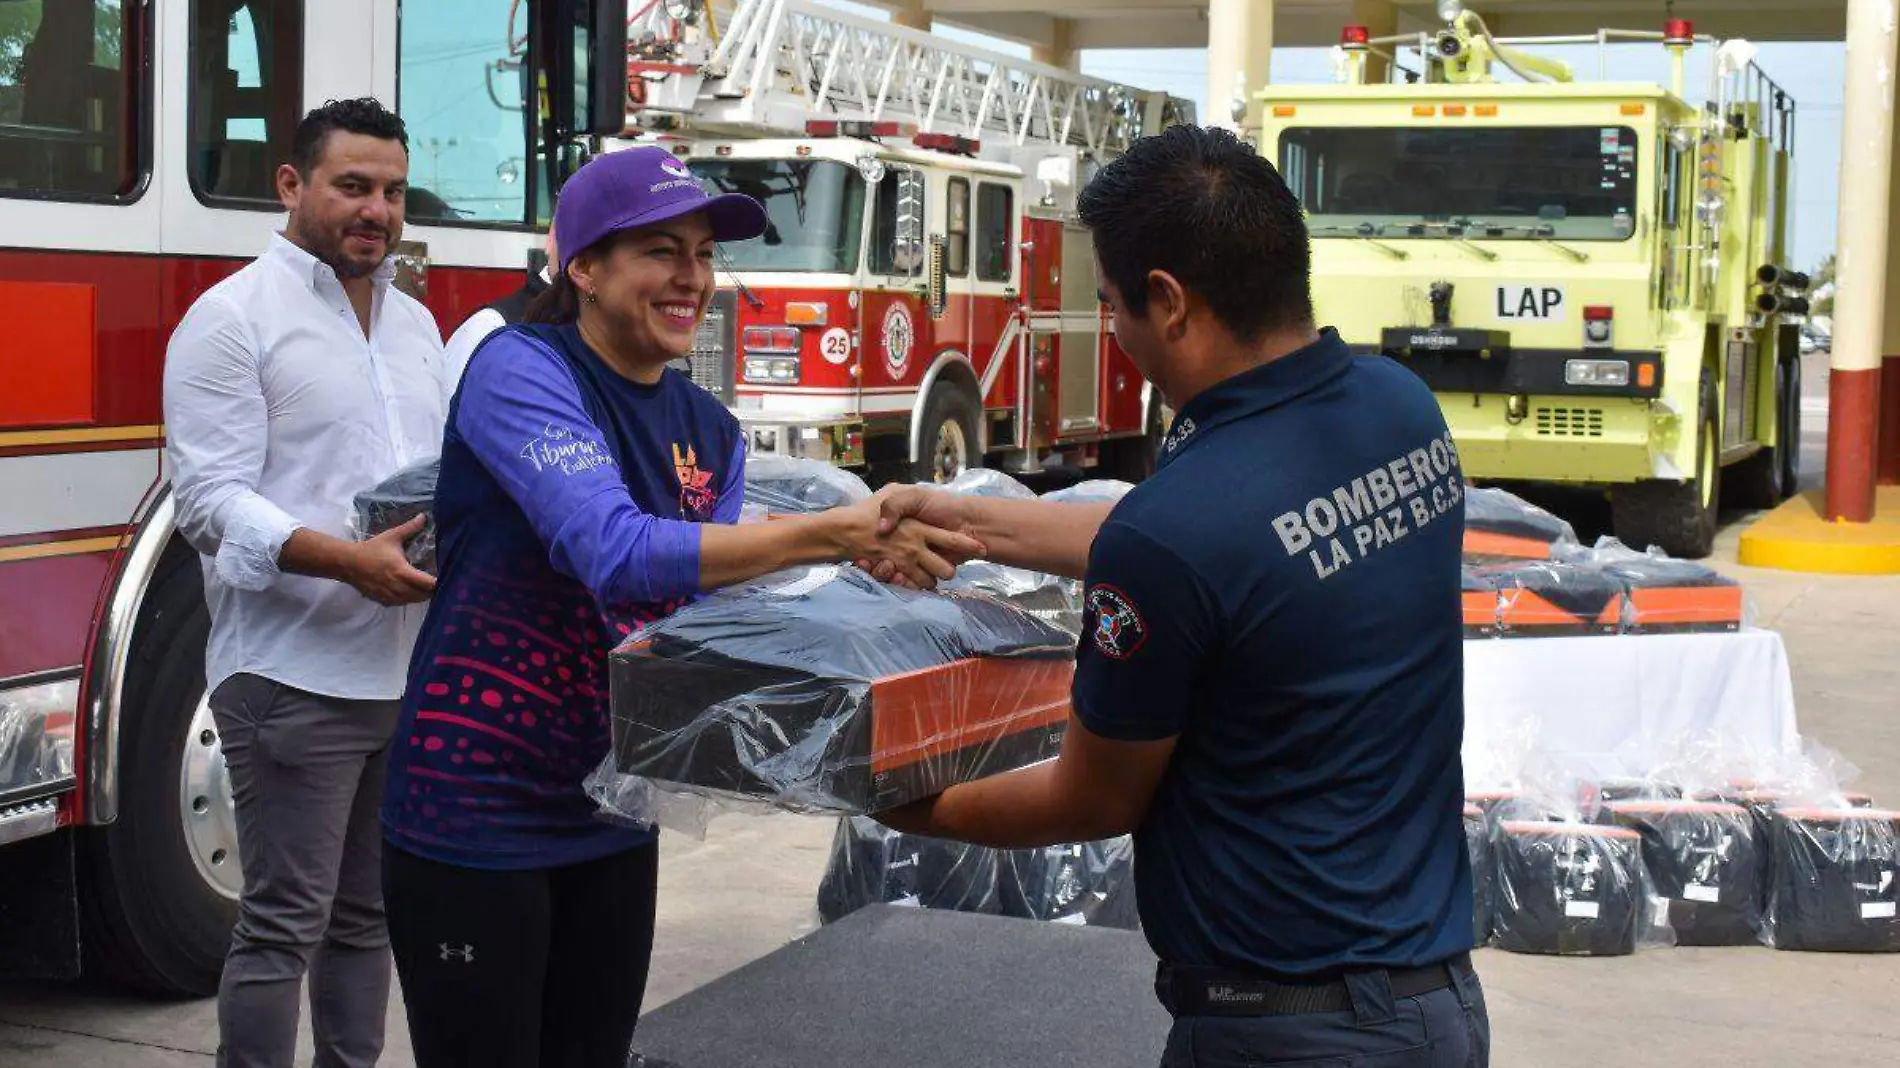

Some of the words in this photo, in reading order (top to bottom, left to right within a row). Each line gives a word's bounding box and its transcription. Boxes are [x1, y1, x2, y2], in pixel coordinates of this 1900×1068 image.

[1497, 287, 1562, 317] LAP
[827, 336, 847, 354] 25
[1271, 430, 1459, 556] BOMBEROS
[1308, 537, 1353, 580] LA
[1353, 506, 1409, 558] PAZ
